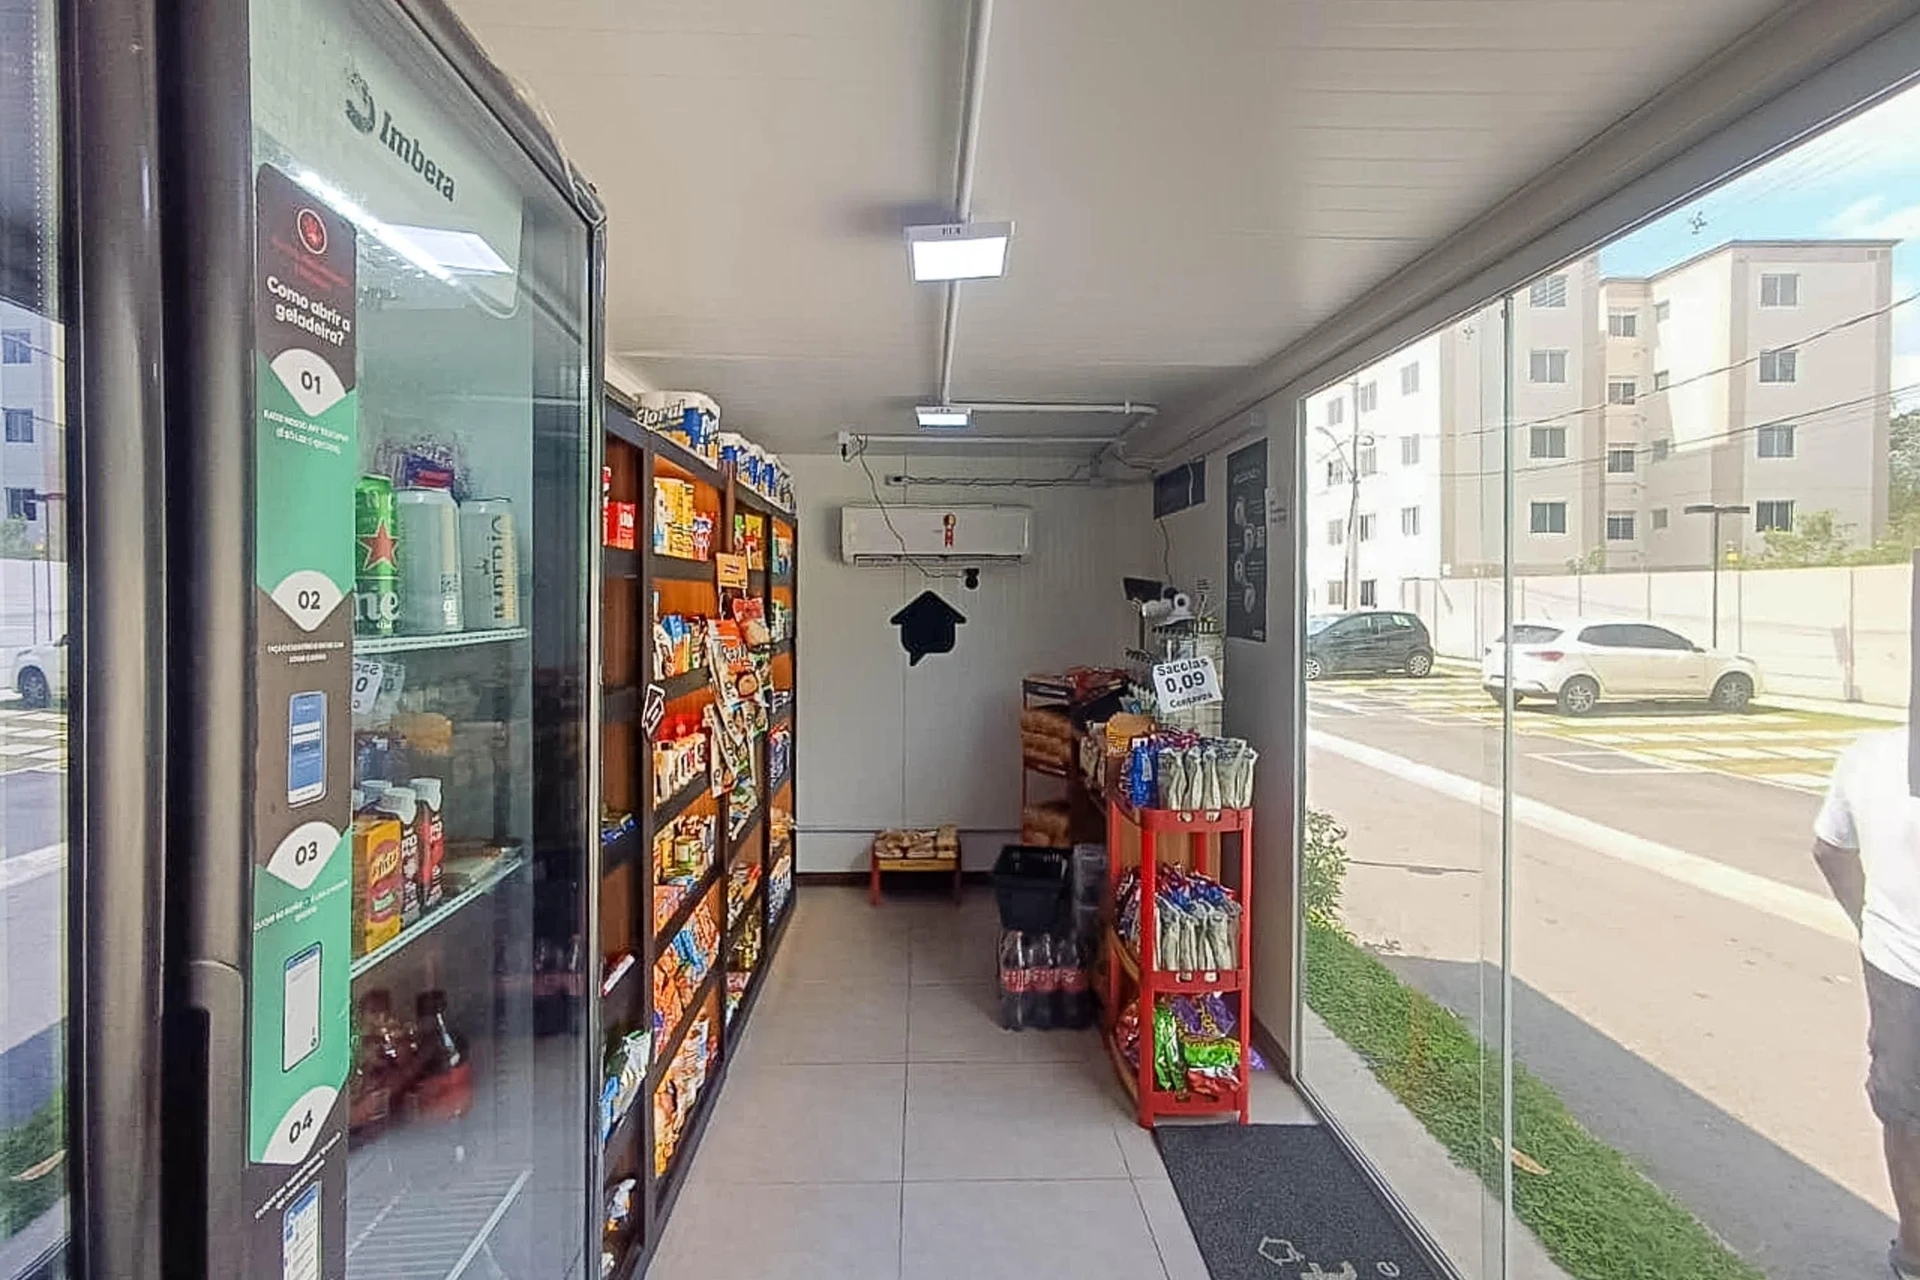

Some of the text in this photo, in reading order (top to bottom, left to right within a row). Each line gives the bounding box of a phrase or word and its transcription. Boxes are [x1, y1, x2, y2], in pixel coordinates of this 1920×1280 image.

[379, 111, 456, 202] Imbera
[266, 276, 351, 332] Como abrir a
[275, 304, 345, 347] geladeira?
[301, 371, 321, 395] 01
[298, 590, 321, 610] 02
[1156, 657, 1209, 677] Sacolas
[1165, 670, 1205, 694] 0,09
[295, 841, 319, 866] 03
[288, 1110, 313, 1144] 04
